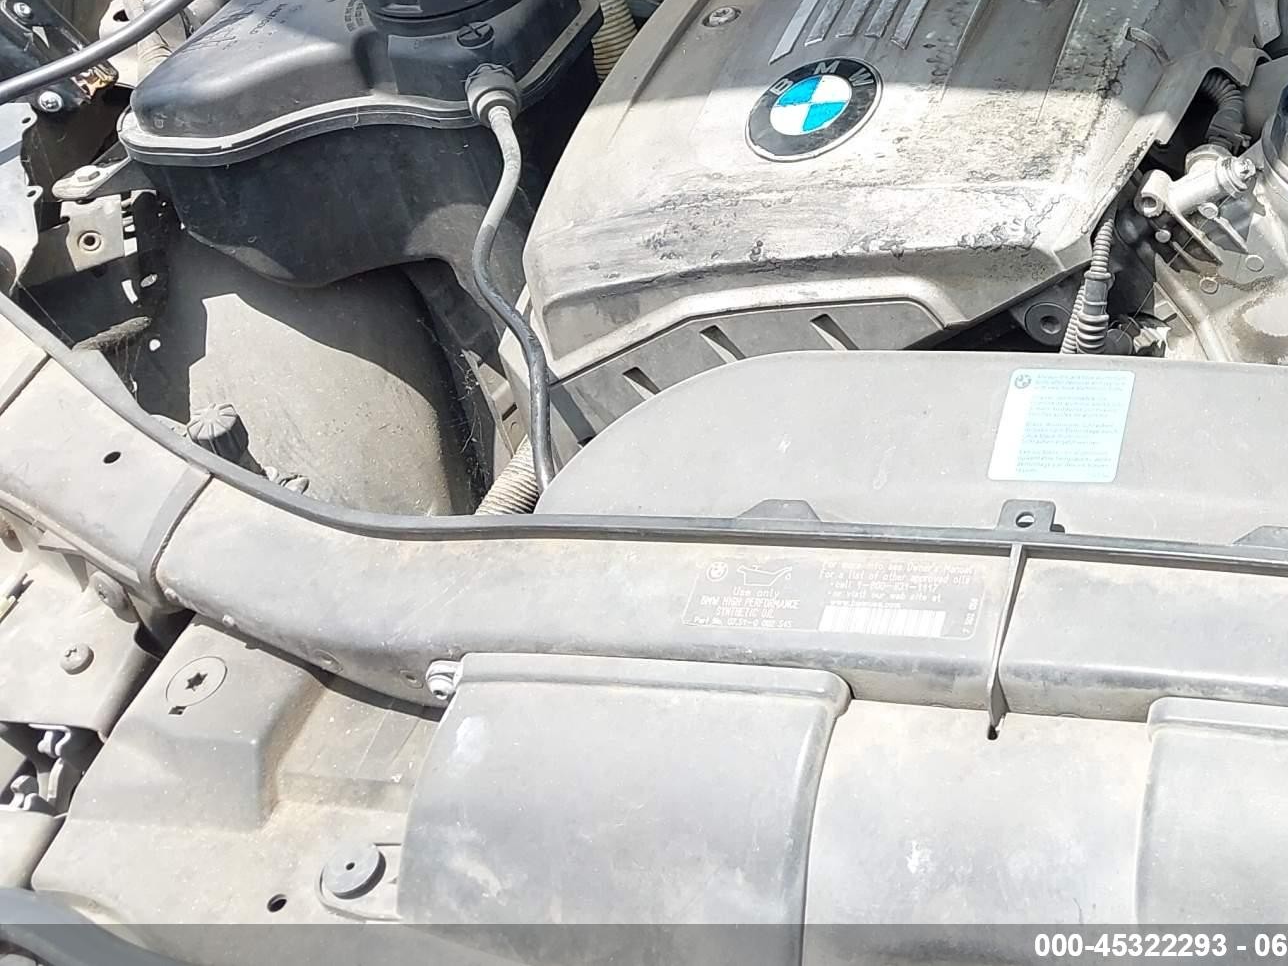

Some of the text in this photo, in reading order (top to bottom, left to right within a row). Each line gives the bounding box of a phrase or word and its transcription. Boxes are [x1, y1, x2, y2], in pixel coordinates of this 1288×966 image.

[769, 60, 874, 96] BMW
[819, 570, 835, 579] For
[848, 570, 865, 580] list
[869, 571, 878, 580] of
[882, 571, 906, 582] other
[910, 574, 949, 585] approved
[953, 575, 970, 586] oils
[732, 586, 780, 600] Use only
[722, 596, 742, 607] HIGH
[744, 597, 800, 610] PERFORMANCE
[716, 606, 760, 618] SYNTHETIC
[694, 616, 710, 624] Part
